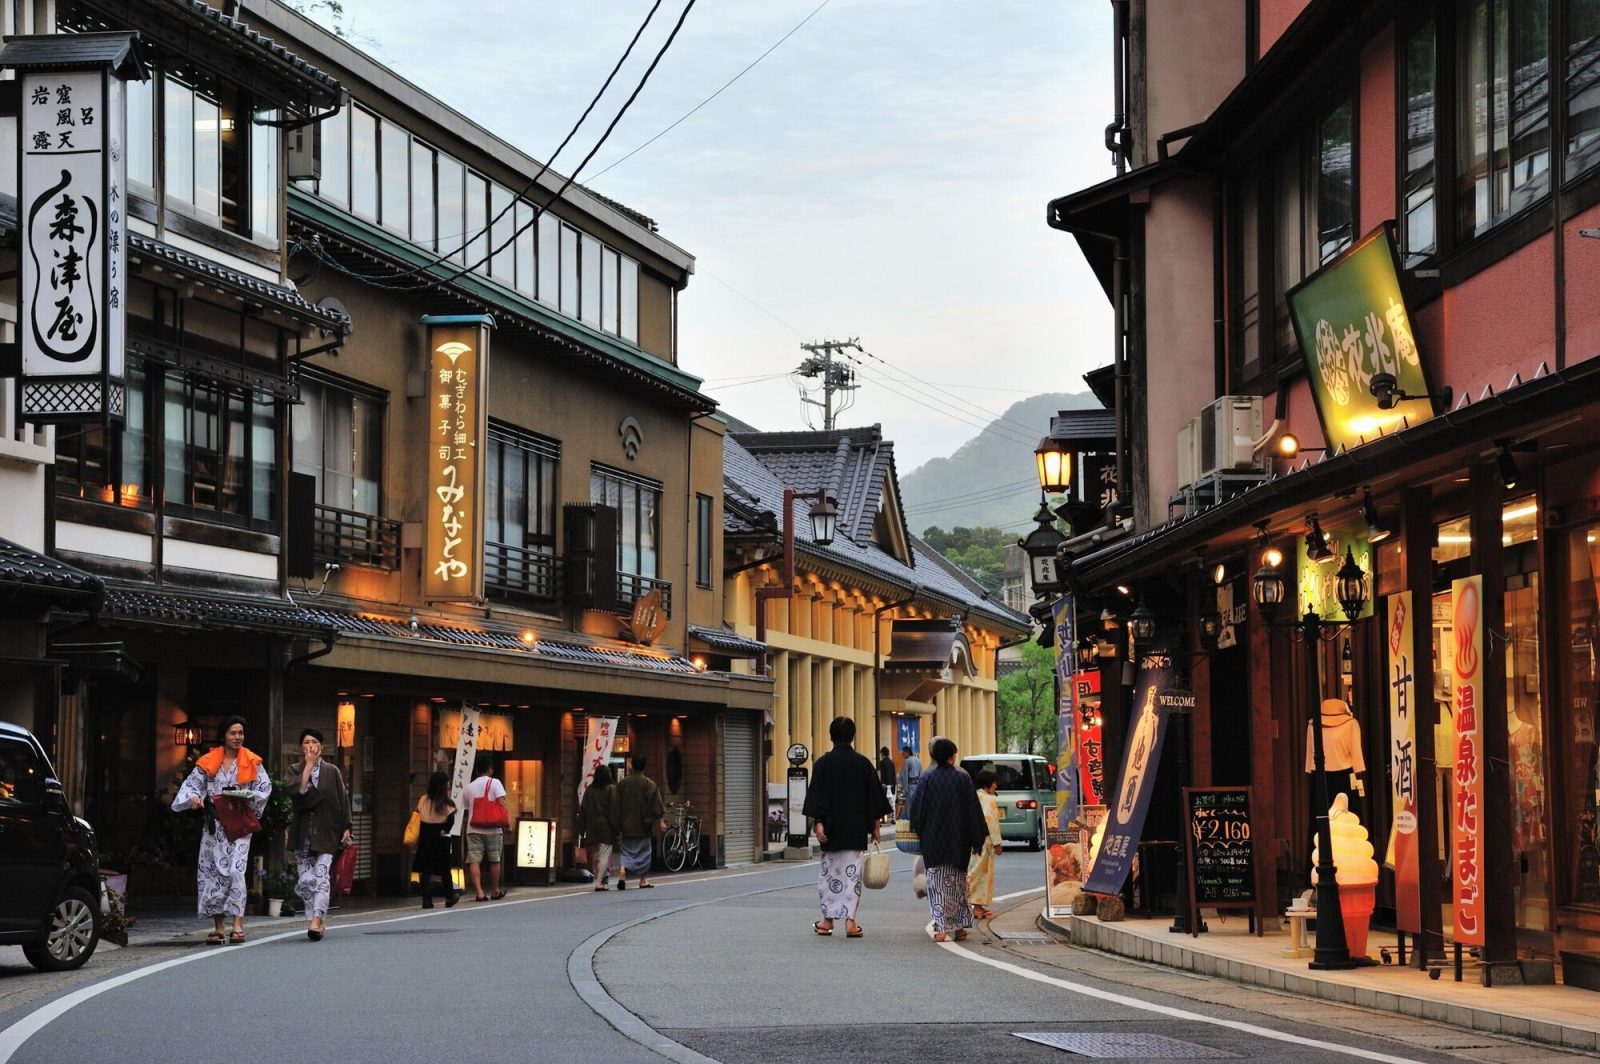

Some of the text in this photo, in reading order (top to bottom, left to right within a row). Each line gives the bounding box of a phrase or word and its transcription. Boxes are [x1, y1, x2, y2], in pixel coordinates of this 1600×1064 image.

[31, 84, 73, 106] 岩窟
[33, 130, 75, 150] 露天
[56, 106, 95, 127] 風呂
[47, 194, 86, 342] 森津屋
[438, 368, 453, 461] 御菓子司
[453, 367, 468, 460] むぎわら細工
[1159, 695, 1196, 707] WELCOME
[1392, 655, 1414, 806] 甘酒
[1455, 684, 1479, 936] 温泉たまご
